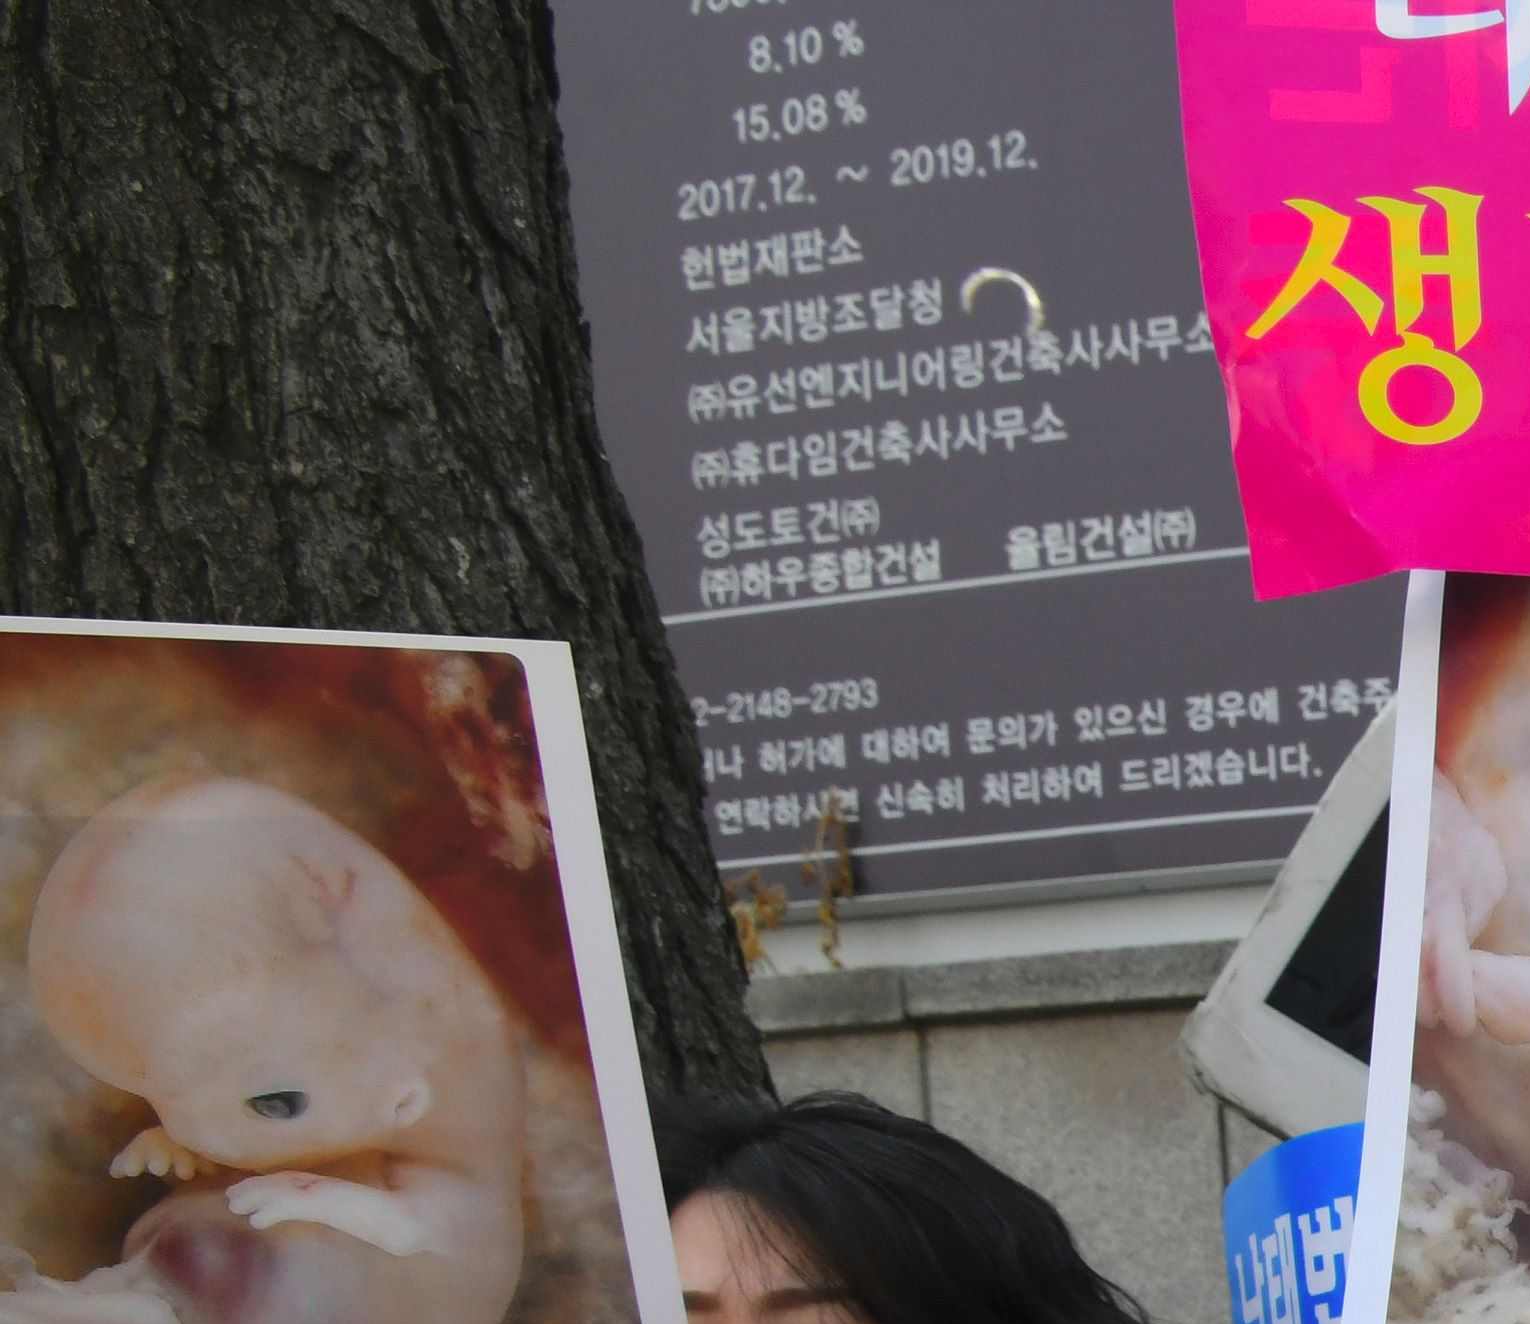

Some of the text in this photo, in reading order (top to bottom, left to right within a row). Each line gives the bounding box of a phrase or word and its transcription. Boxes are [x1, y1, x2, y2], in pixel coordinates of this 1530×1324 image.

[749, 19, 865, 74] 8.10 %
[733, 88, 868, 144] 15.08 %
[678, 167, 817, 222] 2017.12.
[889, 129, 1039, 187] 2019.12.
[681, 224, 865, 292] 헌법재판소
[685, 276, 944, 356] 서울지방조달청
[759, 733, 848, 776] 허가에
[861, 721, 950, 764] 대하여
[966, 709, 1060, 755] 문의가
[1073, 697, 1168, 743] 있으신
[1184, 685, 1280, 733] 경우에
[876, 774, 966, 820] 신속히
[981, 760, 1104, 809] 처리하여
[1119, 740, 1324, 792] 드리겠습니다.
